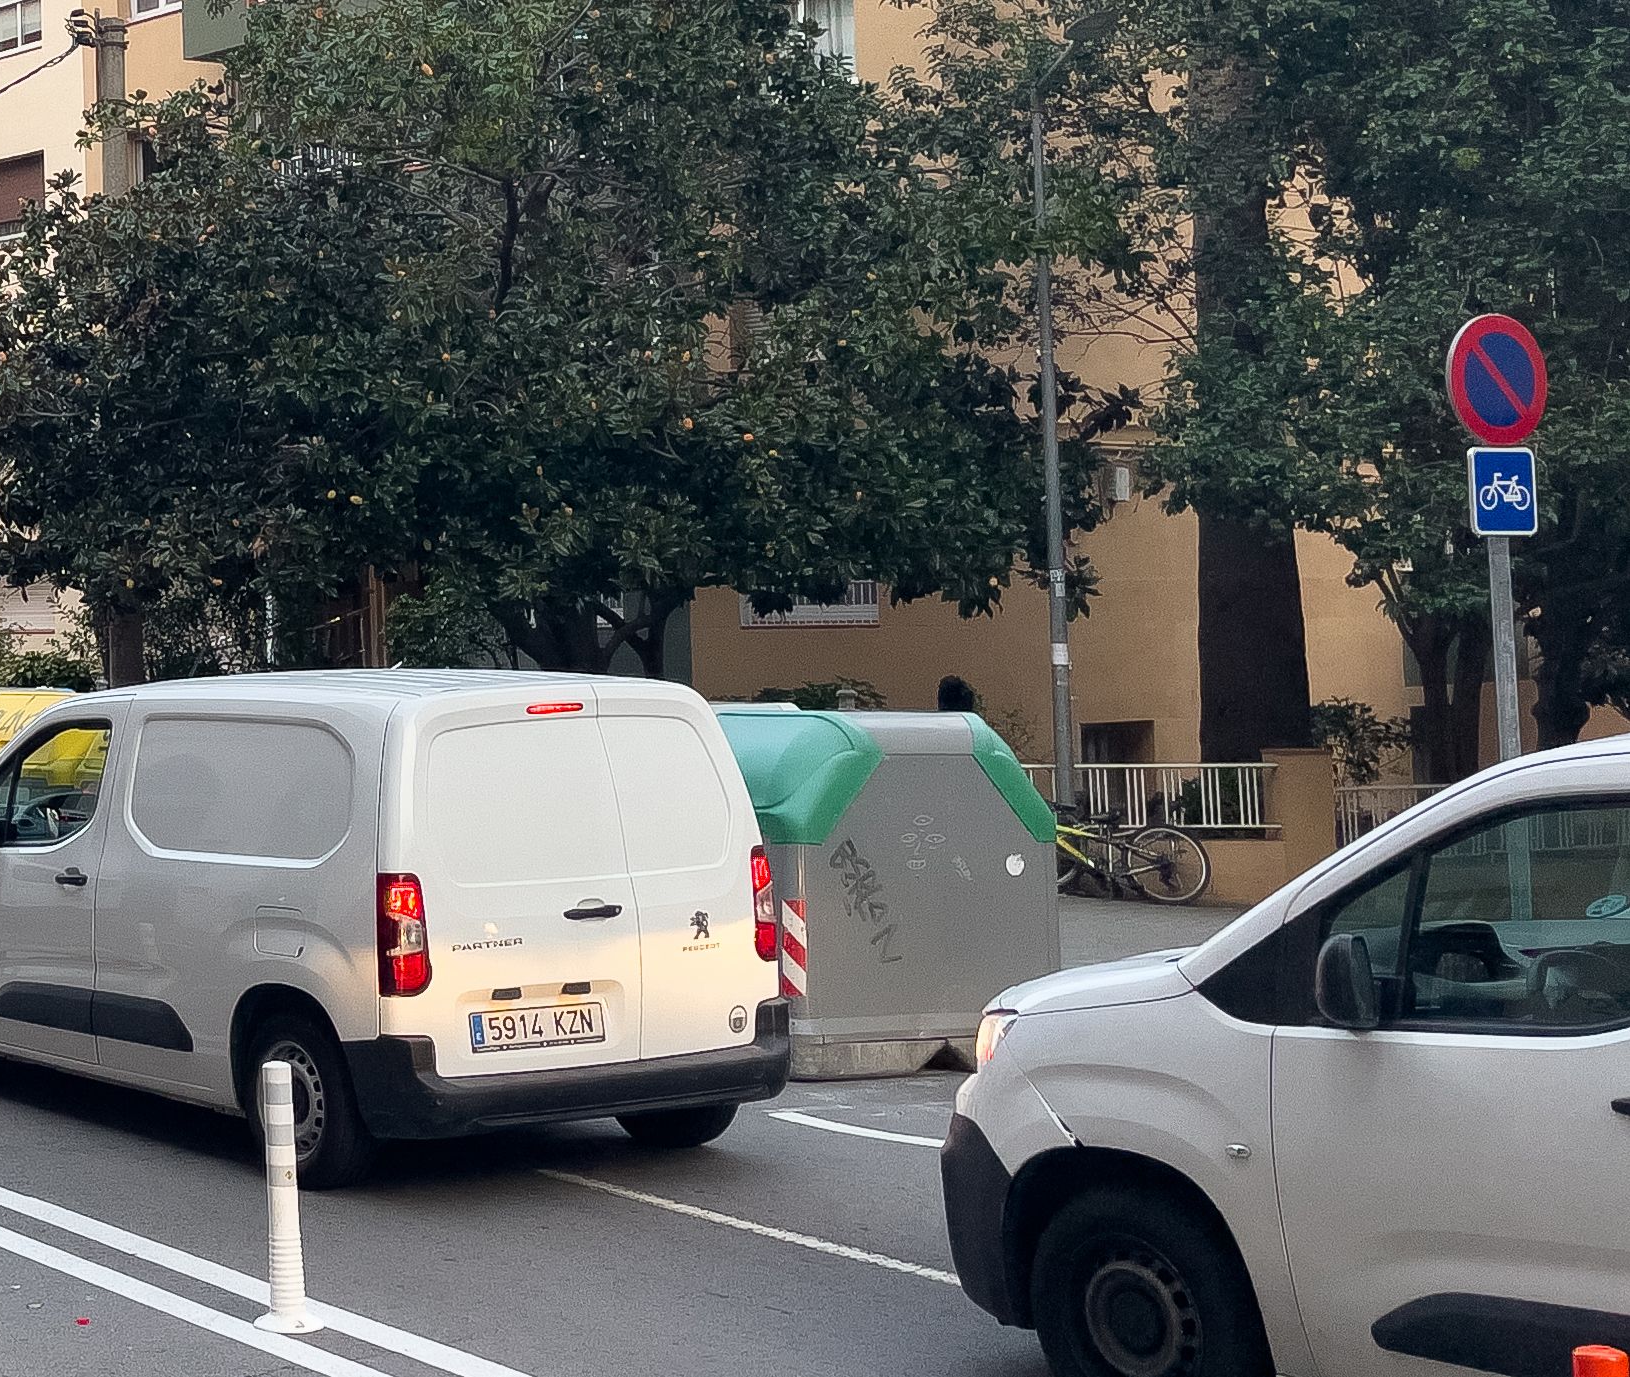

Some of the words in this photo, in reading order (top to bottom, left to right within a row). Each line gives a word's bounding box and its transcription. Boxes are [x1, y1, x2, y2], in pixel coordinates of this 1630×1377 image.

[452, 937, 523, 952] PARTNER
[682, 942, 720, 952] PEUGEOT
[487, 1013, 544, 1041] 5914
[553, 1008, 594, 1036] KZN
